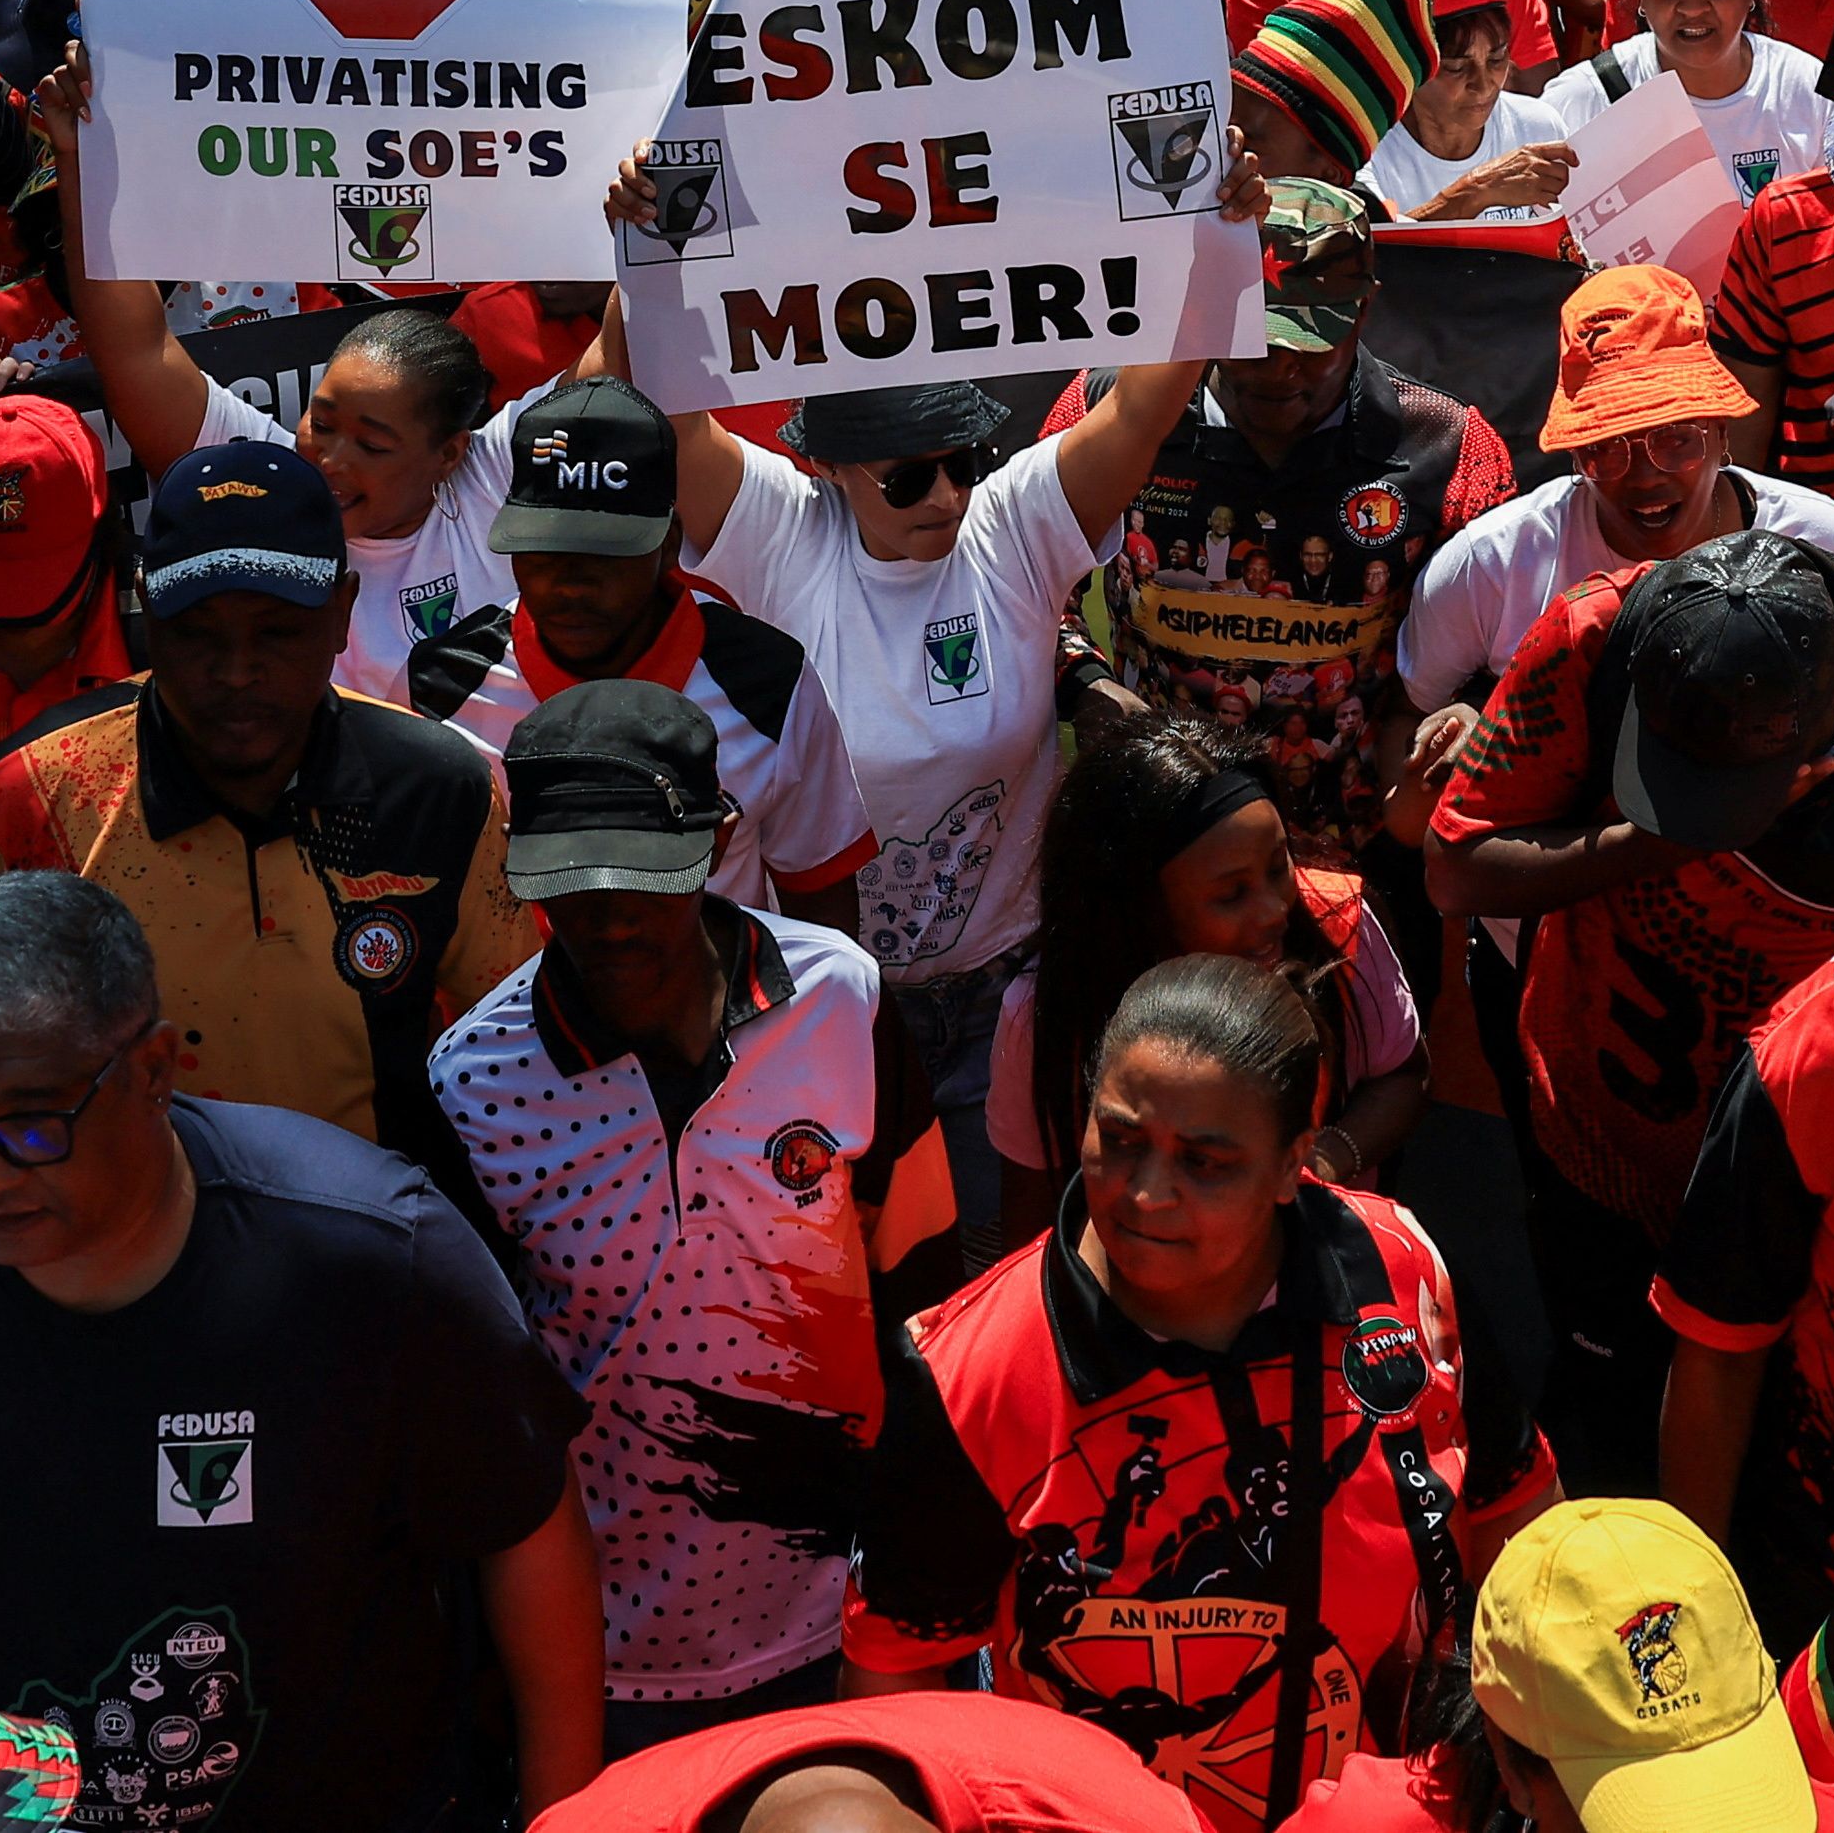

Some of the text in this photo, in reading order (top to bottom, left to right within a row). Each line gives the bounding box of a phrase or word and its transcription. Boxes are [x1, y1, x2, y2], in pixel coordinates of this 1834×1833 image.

[173, 52, 588, 110] PRIVATISING
[1109, 83, 1215, 117] FEDUSA
[197, 123, 569, 180] OUR SOE'S
[335, 184, 430, 207] FEDUSA
[842, 130, 999, 235] SE
[720, 254, 1143, 374] MOER!
[557, 458, 629, 492] MIC
[399, 575, 458, 606] FEDUSA
[922, 612, 979, 642] FEDUSA
[157, 1409, 256, 1438] FEDUSA
[1108, 1604, 1280, 1632] AN INJURY TO
[169, 1637, 222, 1654] NTEU
[1635, 1692, 1703, 1721] COSATU
